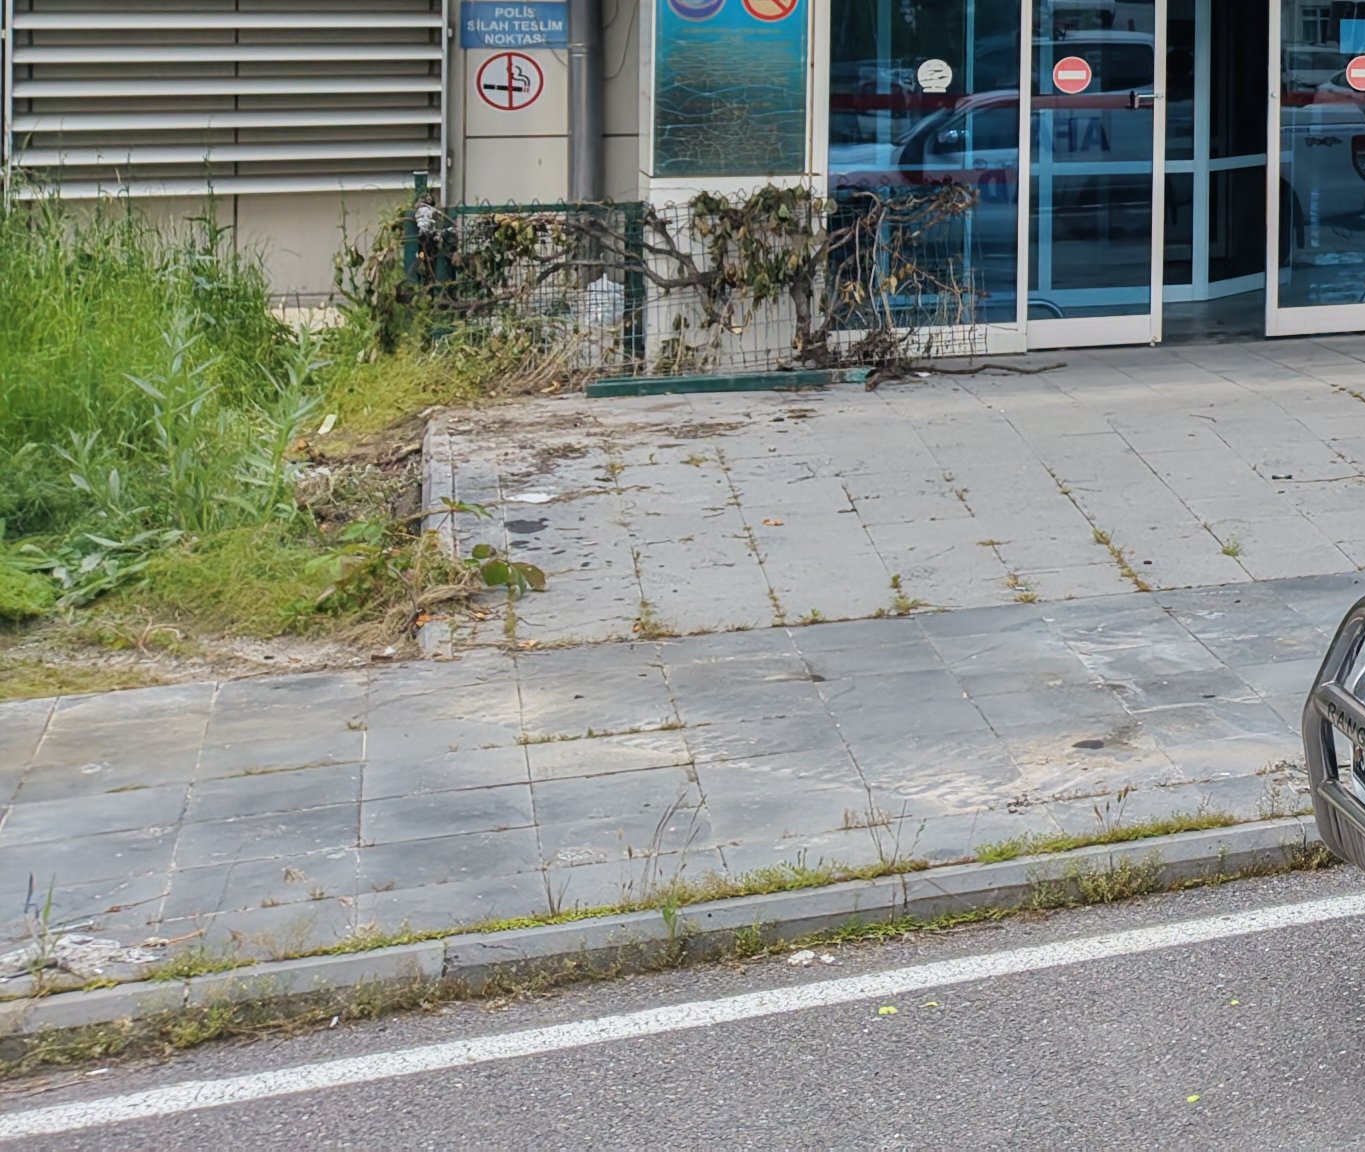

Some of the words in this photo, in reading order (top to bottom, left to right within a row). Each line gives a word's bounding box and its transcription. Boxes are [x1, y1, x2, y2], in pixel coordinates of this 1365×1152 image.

[495, 6, 536, 19] POLİS
[467, 19, 509, 32] SİLAH
[513, 20, 563, 32] TESLİM
